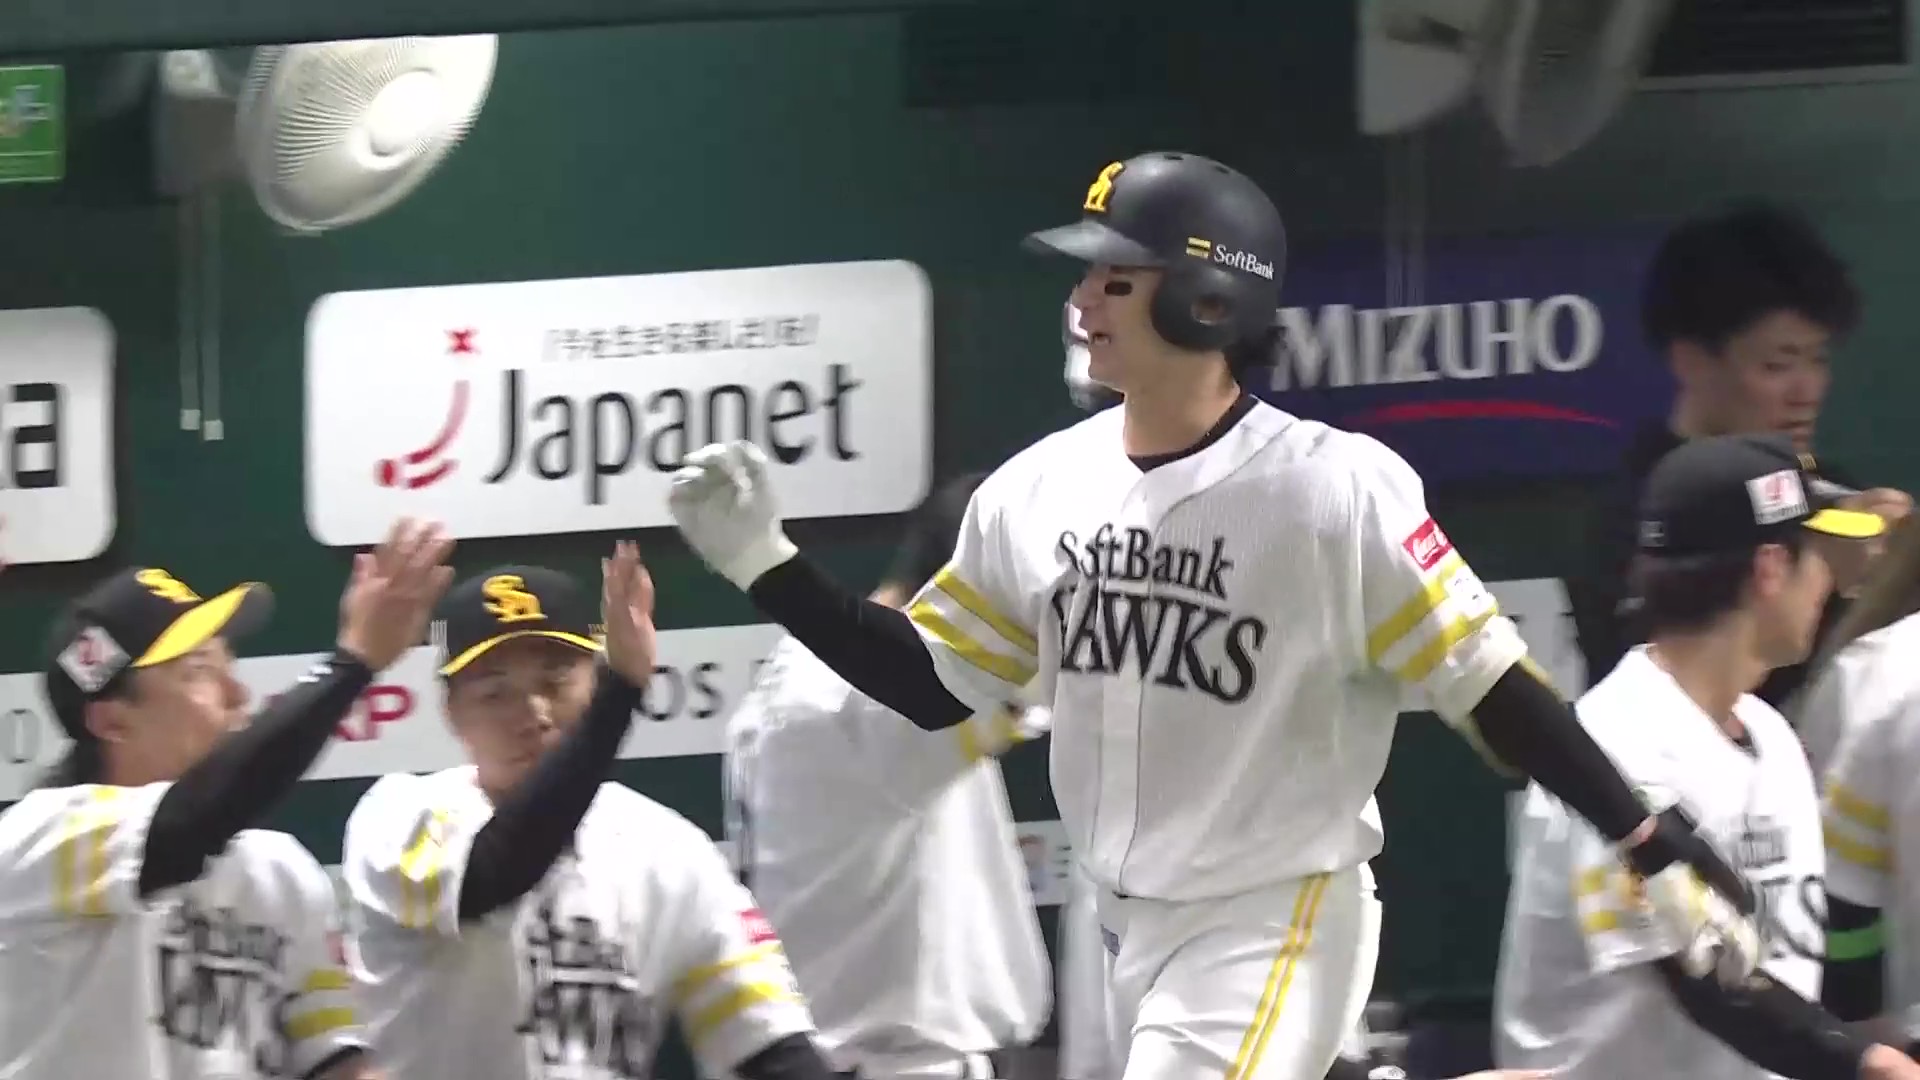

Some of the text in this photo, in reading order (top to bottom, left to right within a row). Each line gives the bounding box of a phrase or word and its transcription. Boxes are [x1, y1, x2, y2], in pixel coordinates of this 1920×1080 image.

[1213, 244, 1275, 281] SoftBank
[1270, 294, 1602, 392] MIZUHO
[481, 363, 865, 505] Japanet
